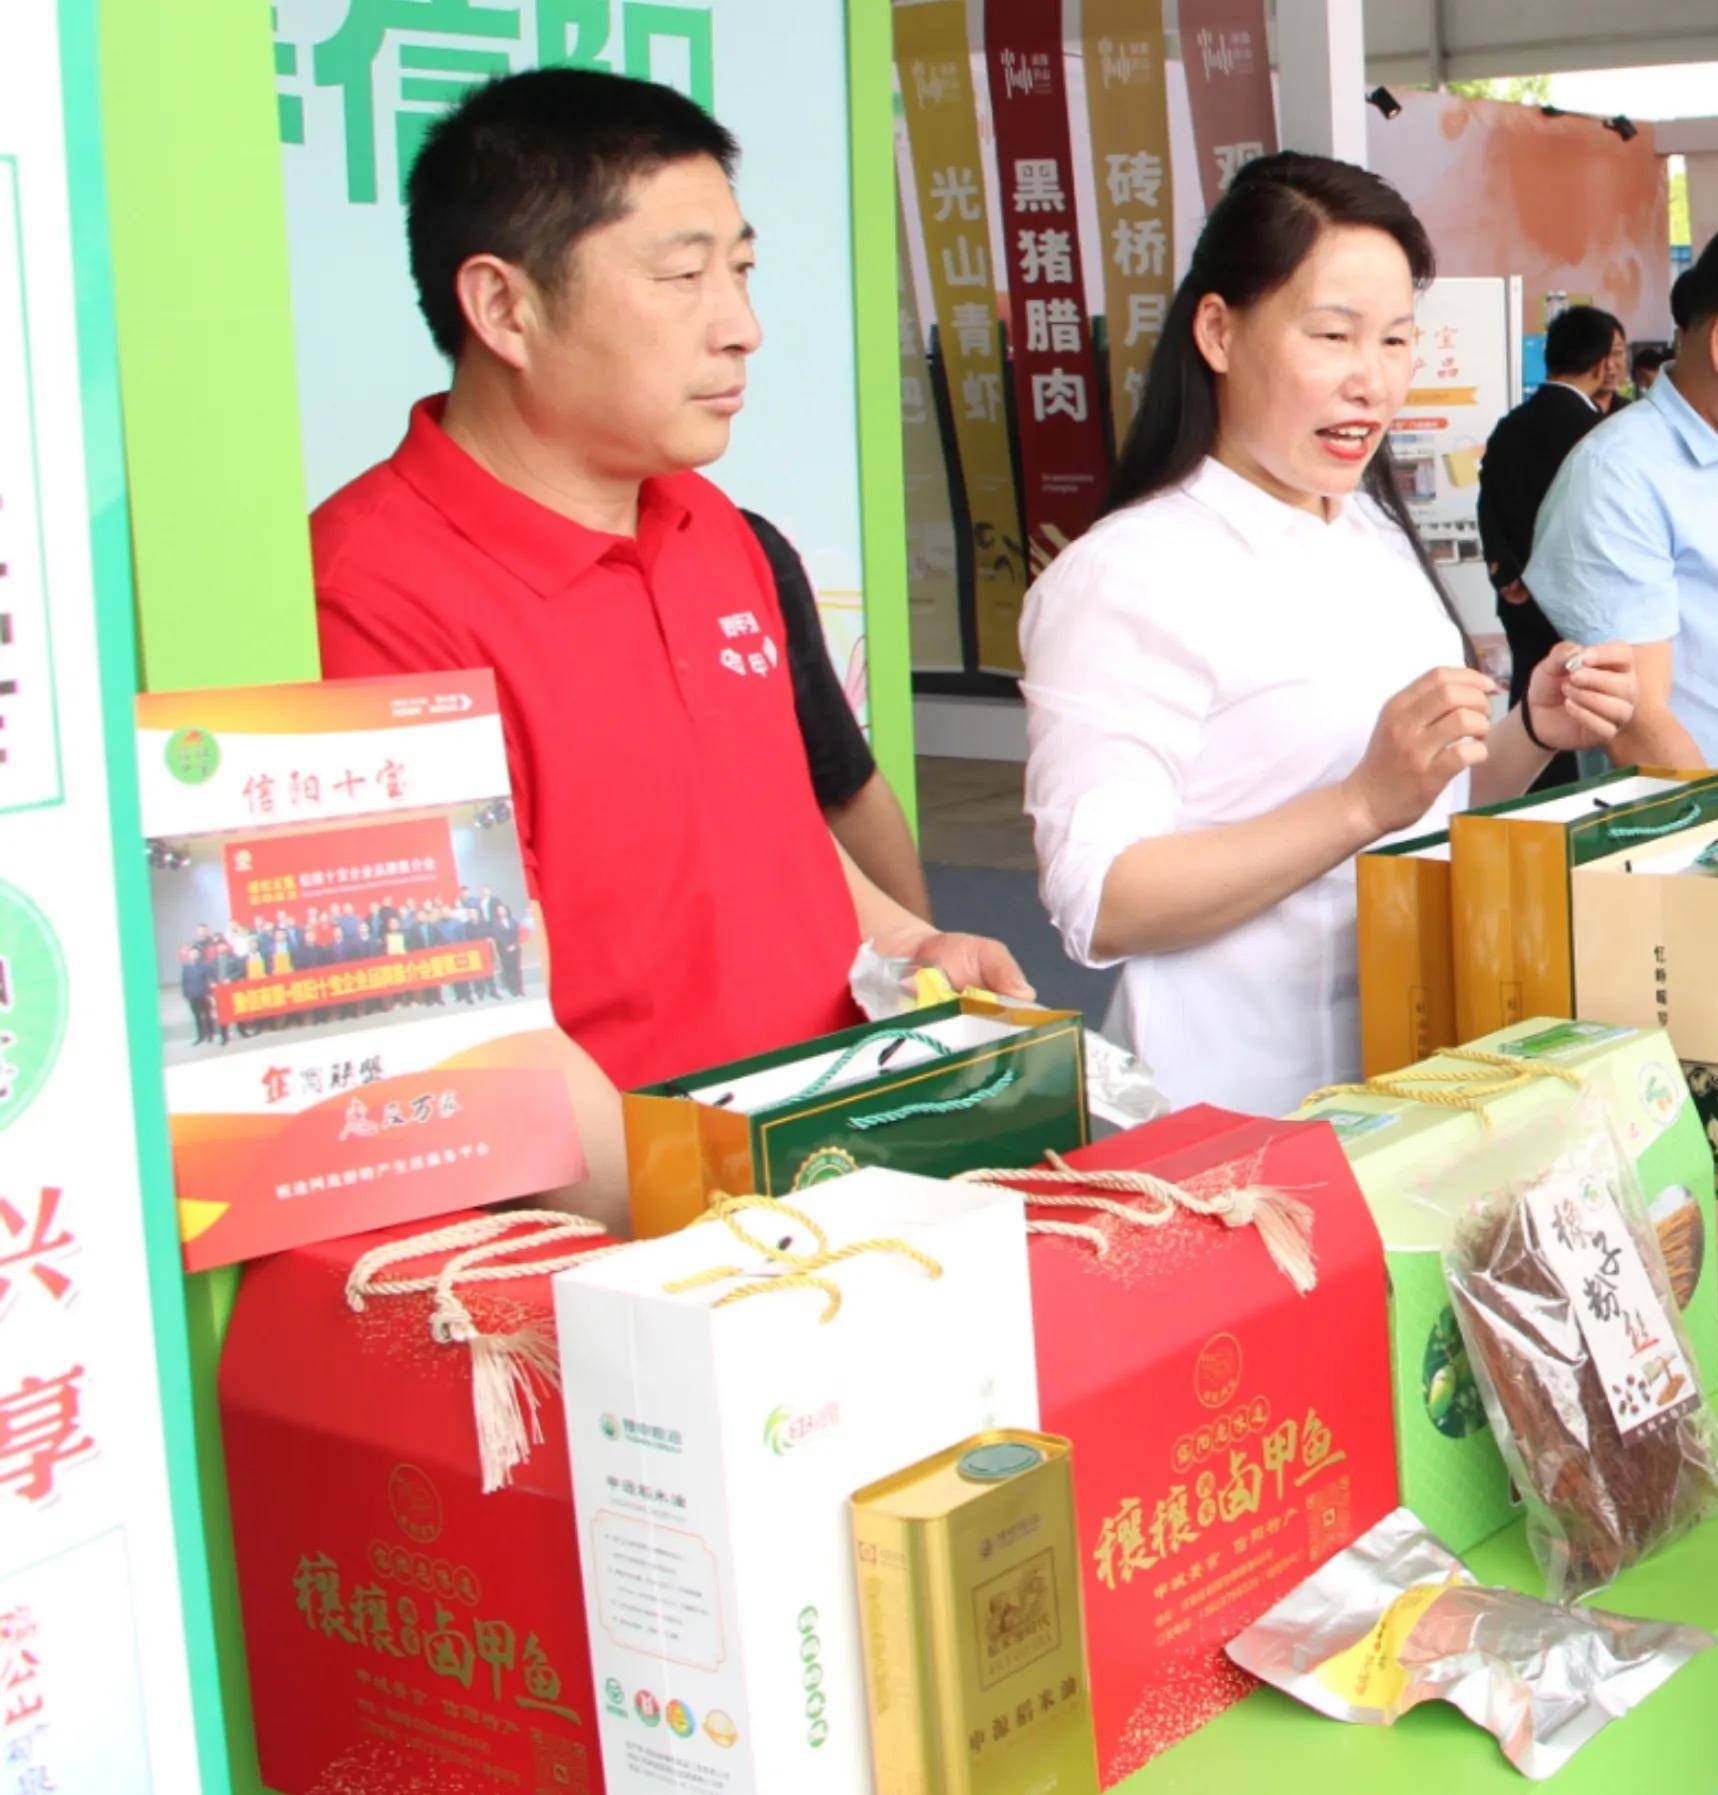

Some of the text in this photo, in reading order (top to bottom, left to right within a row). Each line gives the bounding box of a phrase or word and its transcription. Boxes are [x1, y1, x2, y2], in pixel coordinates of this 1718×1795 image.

[930, 164, 1002, 425] 光山青虾
[1012, 157, 1089, 424] 黑猪腊肉
[242, 758, 409, 812] 信阳十宝
